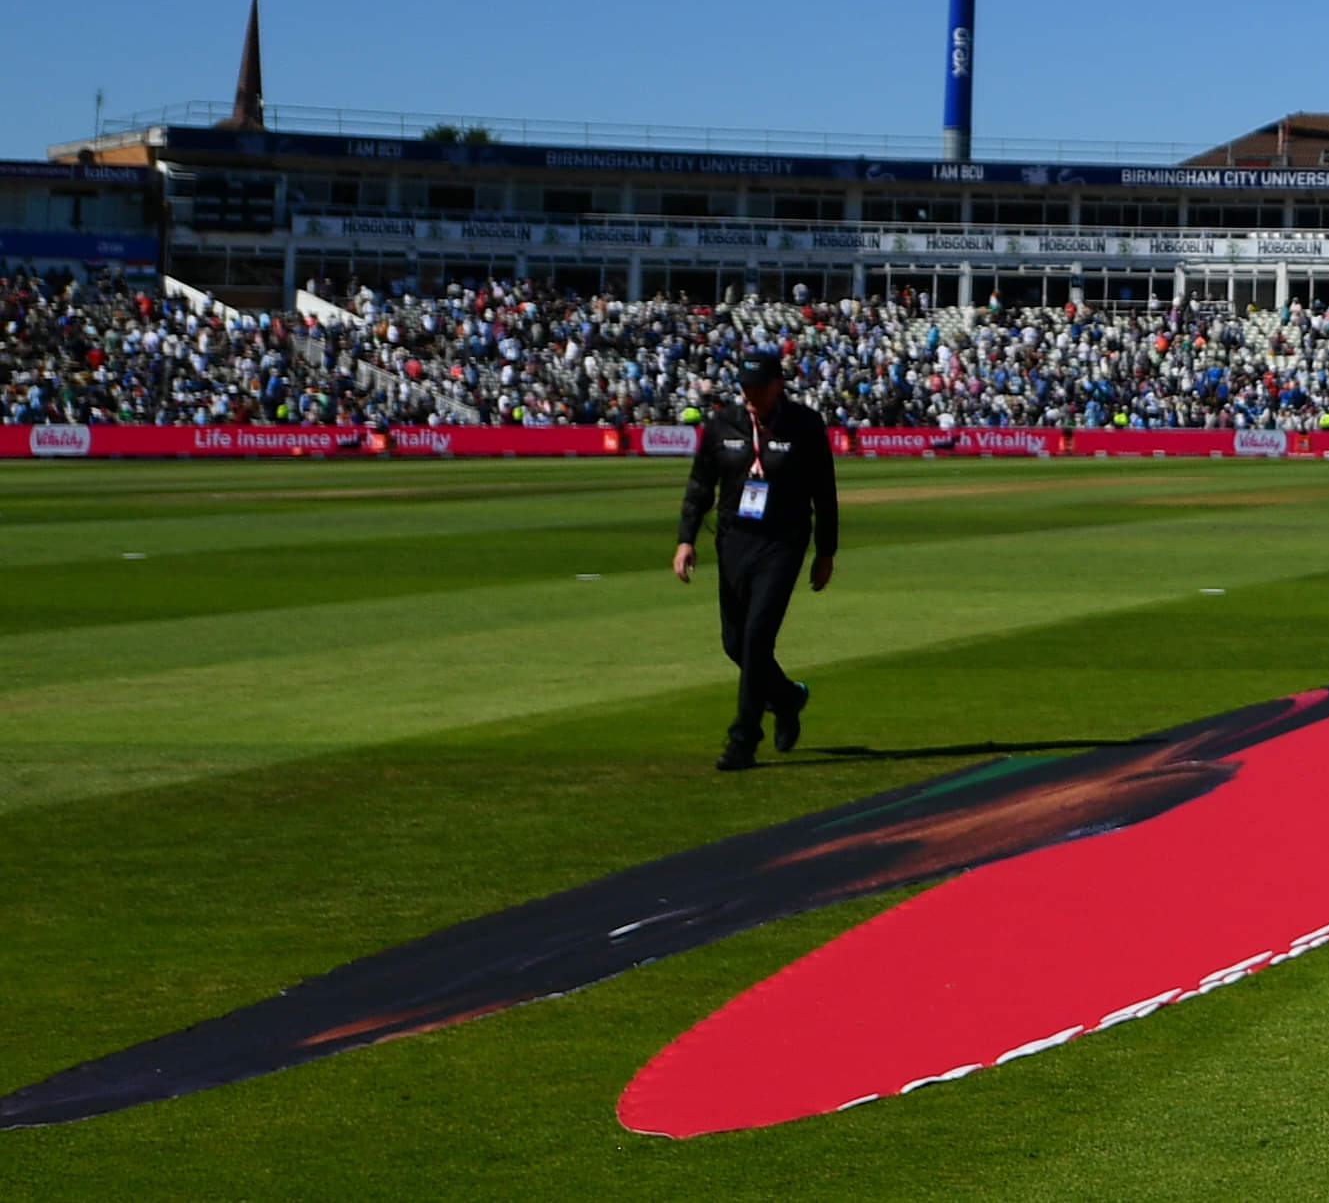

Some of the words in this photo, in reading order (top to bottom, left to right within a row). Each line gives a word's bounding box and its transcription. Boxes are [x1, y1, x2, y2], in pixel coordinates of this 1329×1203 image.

[546, 151, 656, 170] BIRMINGHAM
[659, 154, 694, 172] CITY
[700, 156, 794, 174] UNIVERSITY
[939, 164, 958, 180] AM
[961, 164, 984, 180] BCU
[1121, 169, 1220, 184] BIRMINGHAM
[1224, 170, 1257, 185] CITY
[343, 217, 415, 238] HOBGOBLIN
[462, 221, 531, 242] HOBGOBLIN
[579, 225, 650, 245] HOBGOBLIN
[698, 227, 768, 247] HOBGOBLIN
[813, 230, 881, 250] HOBGOBLIN
[926, 234, 994, 251] HOBGOBLIN
[1039, 236, 1106, 253] HOBGOBLIN
[1150, 239, 1214, 254] HOBGOBLIN
[1257, 240, 1322, 255] HOBGOBLIN
[195, 429, 232, 446] Life
[237, 430, 331, 446] insurance
[336, 430, 376, 447] wih
[394, 429, 451, 449] itality
[930, 431, 972, 447] wih
[976, 431, 1046, 450] Vitality
